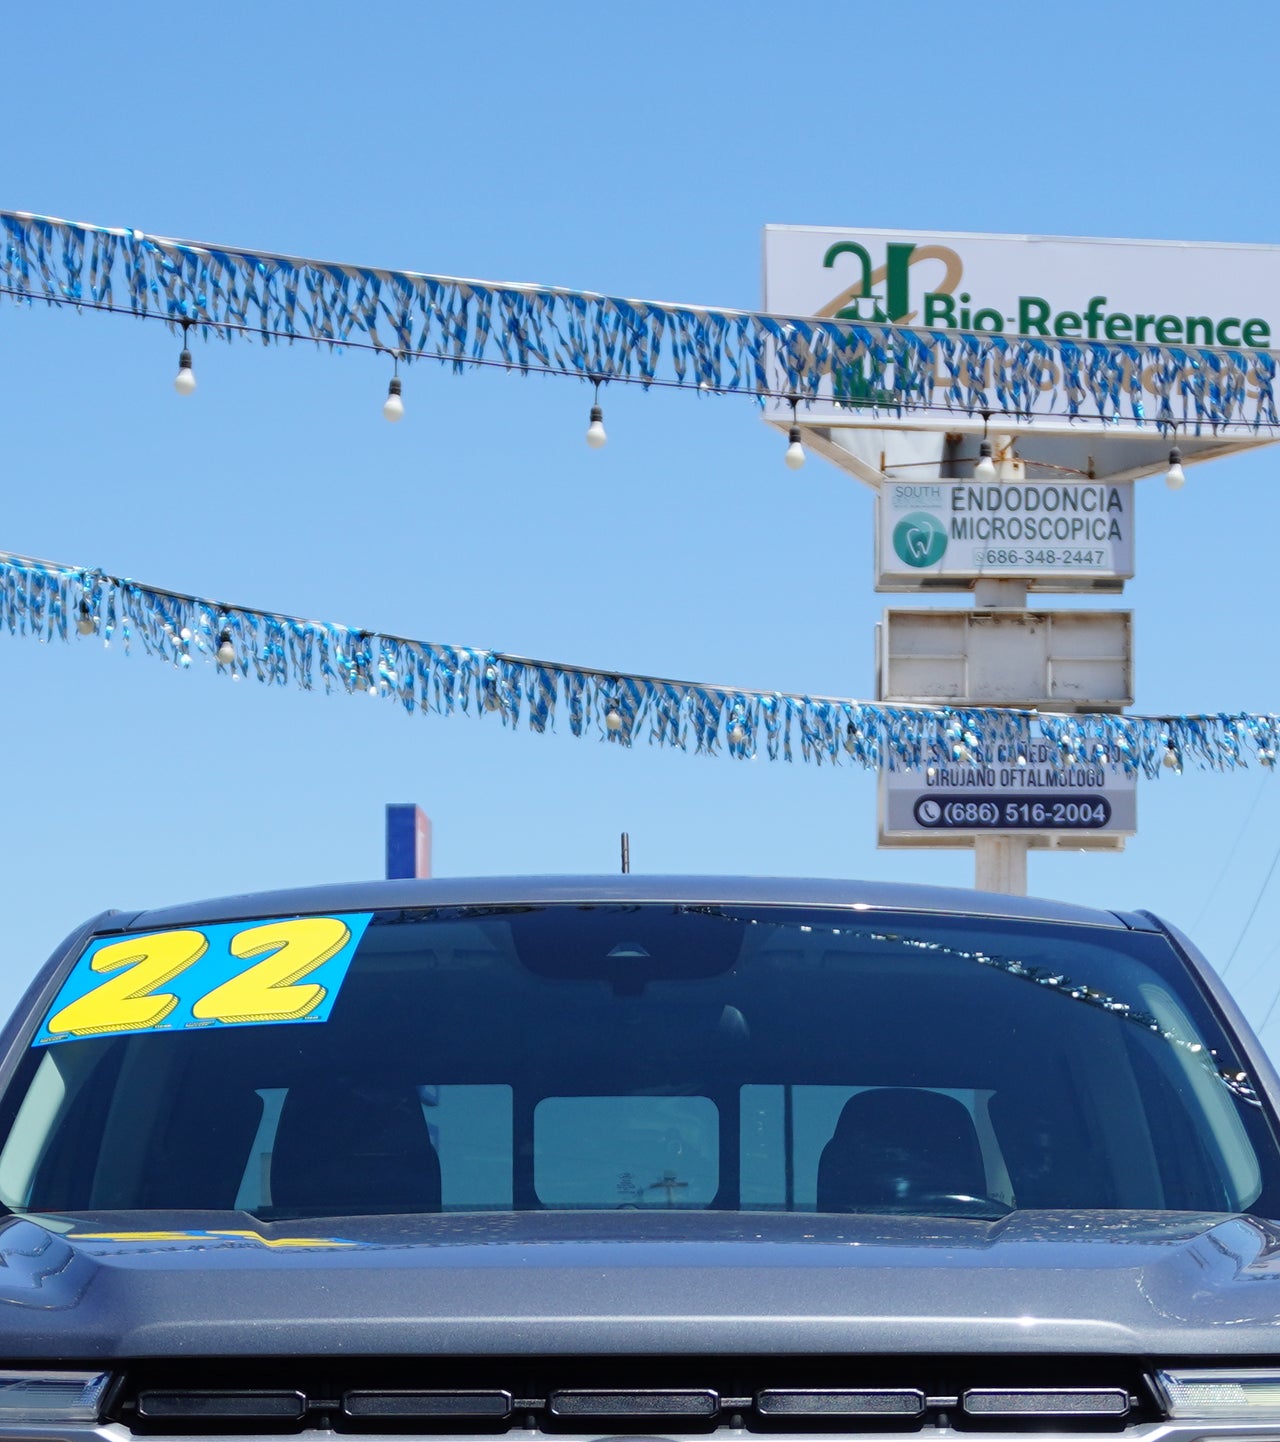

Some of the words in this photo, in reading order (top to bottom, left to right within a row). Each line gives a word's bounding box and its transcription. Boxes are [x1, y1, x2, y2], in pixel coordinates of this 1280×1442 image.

[924, 292, 1271, 347] Bio-Reference
[895, 486, 940, 498] SOUTH
[951, 486, 1123, 513] ENDODONCIA
[951, 516, 1123, 541] MICROSCOPICA
[986, 549, 1105, 565] 686-348-2447
[926, 768, 996, 787] CIRUJANO
[943, 802, 999, 824] (686)
[1005, 803, 1106, 823] 516-2004
[48, 916, 352, 1037] 22
